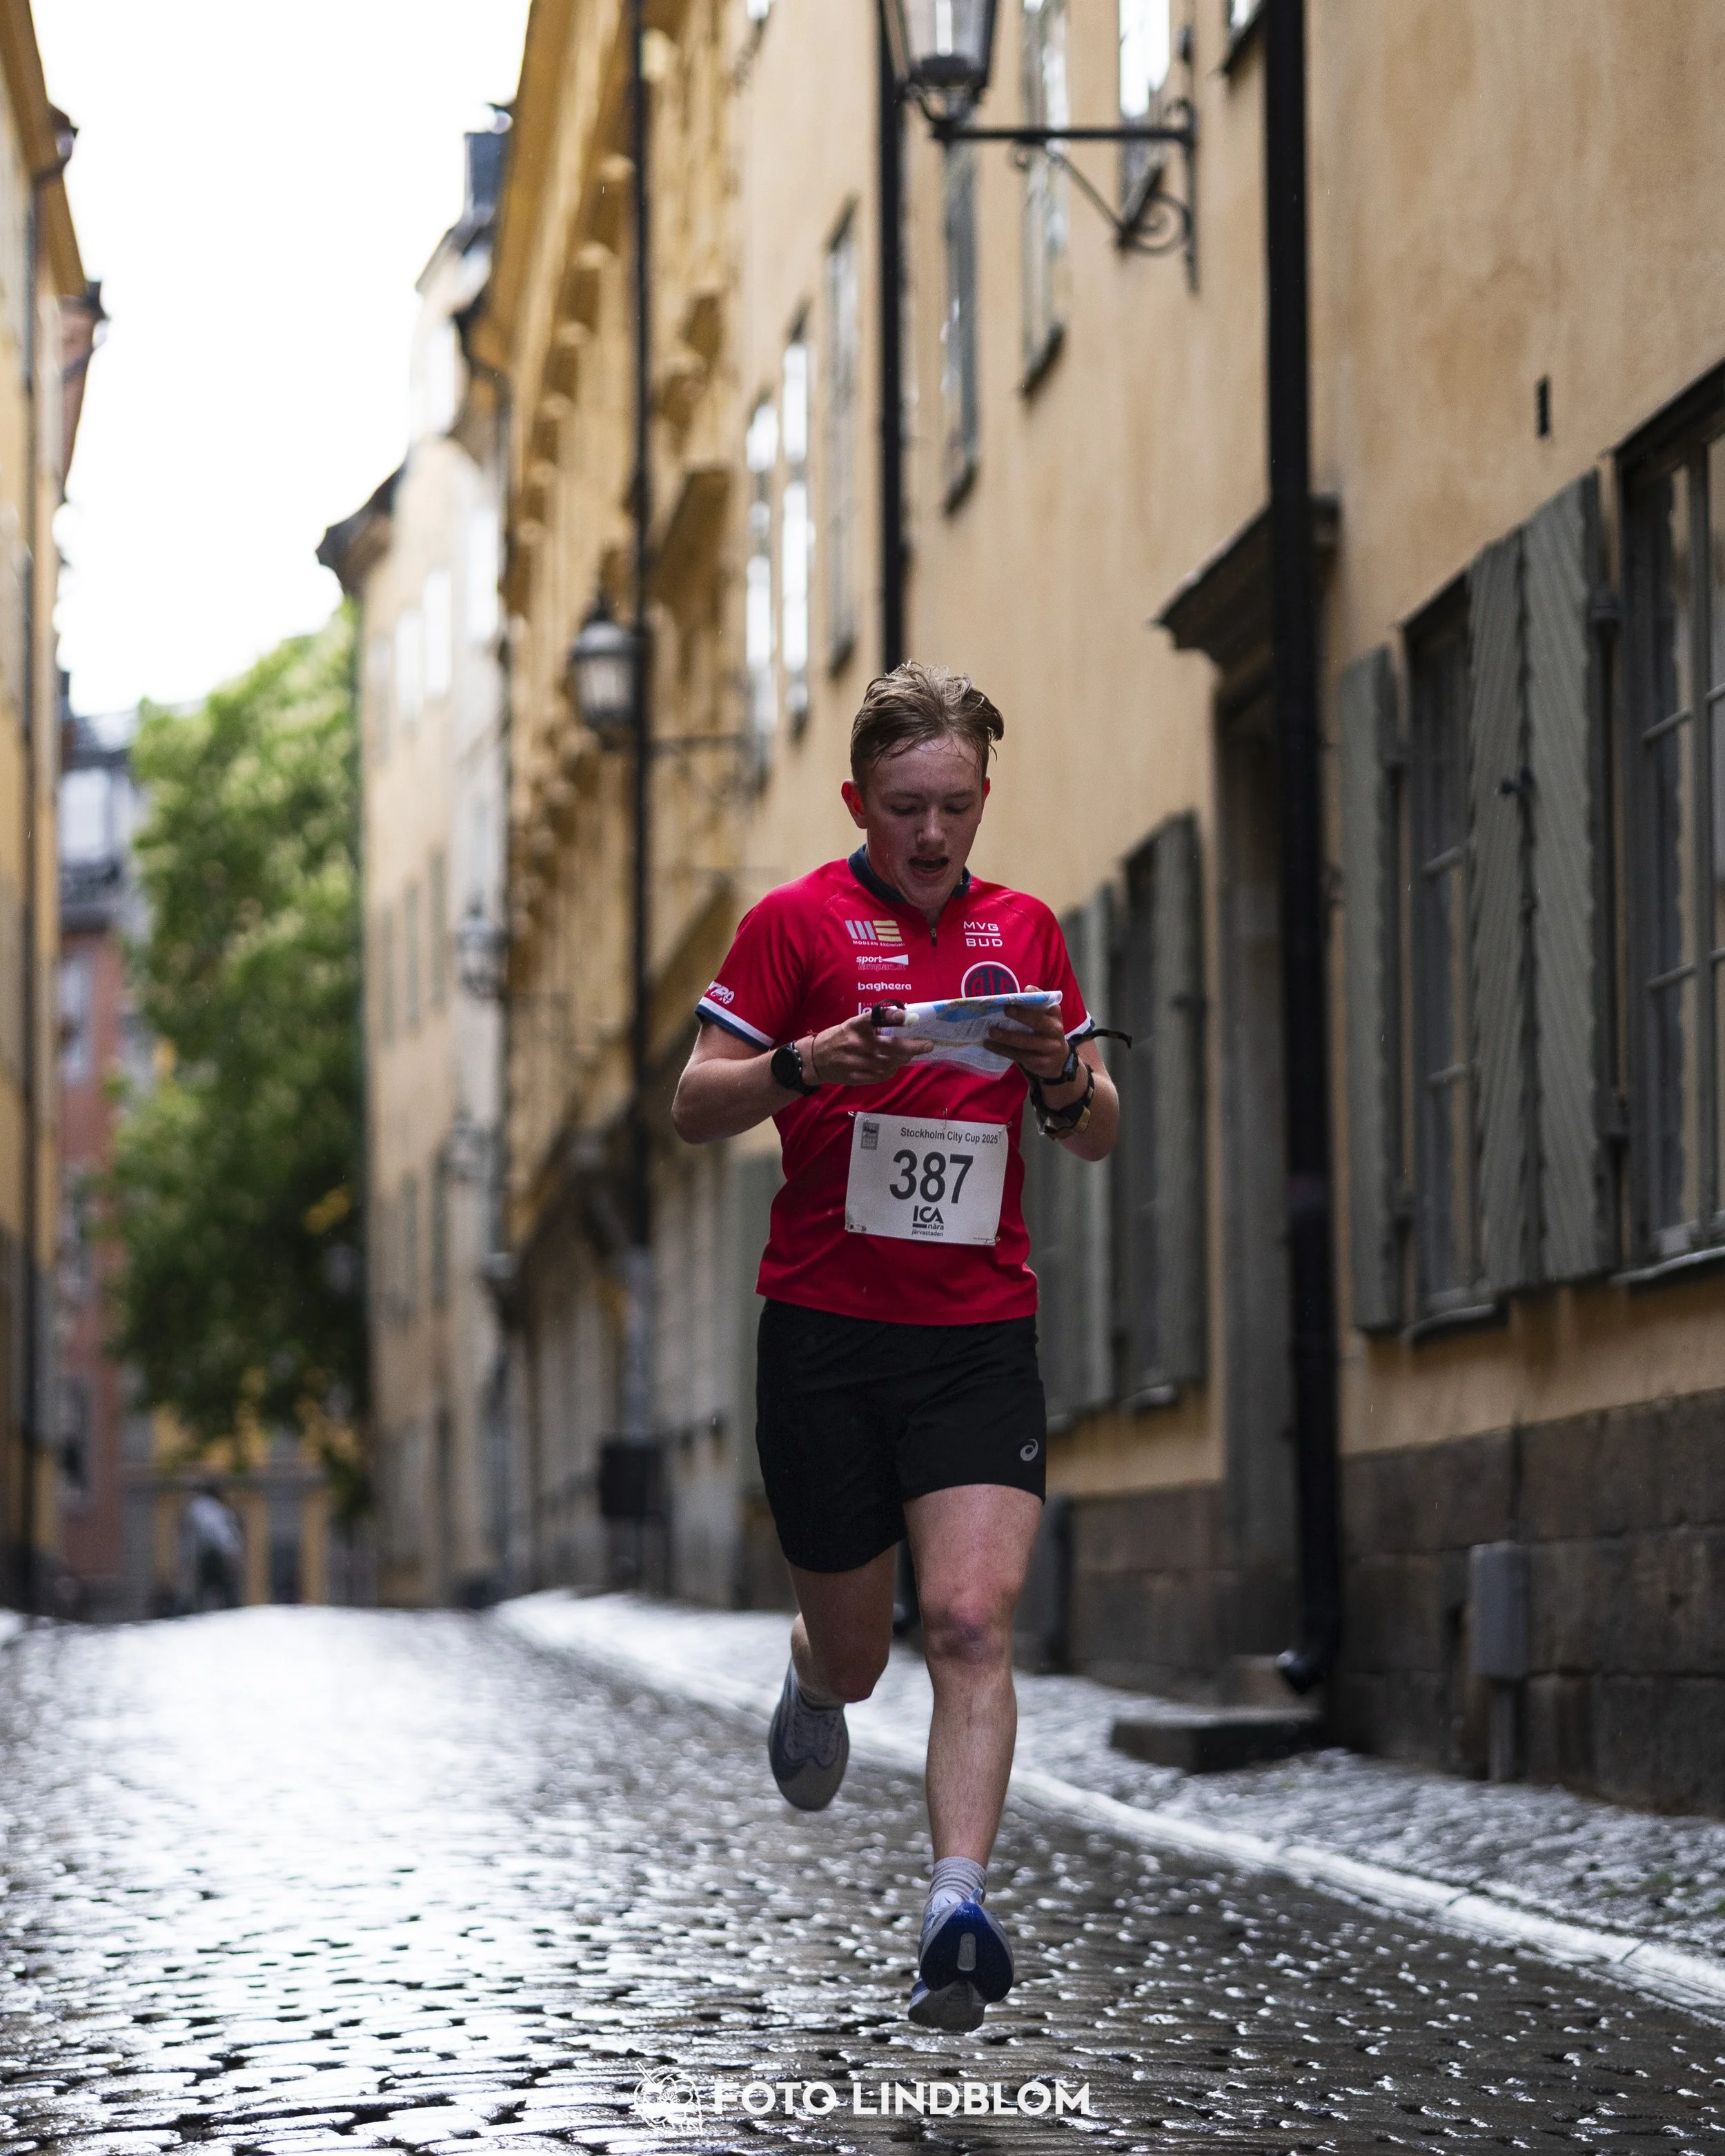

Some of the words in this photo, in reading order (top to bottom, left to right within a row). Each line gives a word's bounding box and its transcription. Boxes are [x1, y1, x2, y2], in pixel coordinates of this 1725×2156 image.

[963, 920, 999, 931] MVG
[966, 938, 1003, 947] BUD
[856, 955, 883, 964] sport
[858, 981, 911, 991] bagheera
[900, 1127, 945, 1140] Stockholm
[947, 1131, 963, 1143] City
[965, 1132, 980, 1144] Cup
[982, 1134, 998, 1144] 2025
[889, 1149, 974, 1204] 387
[913, 1205, 944, 1224] ICA
